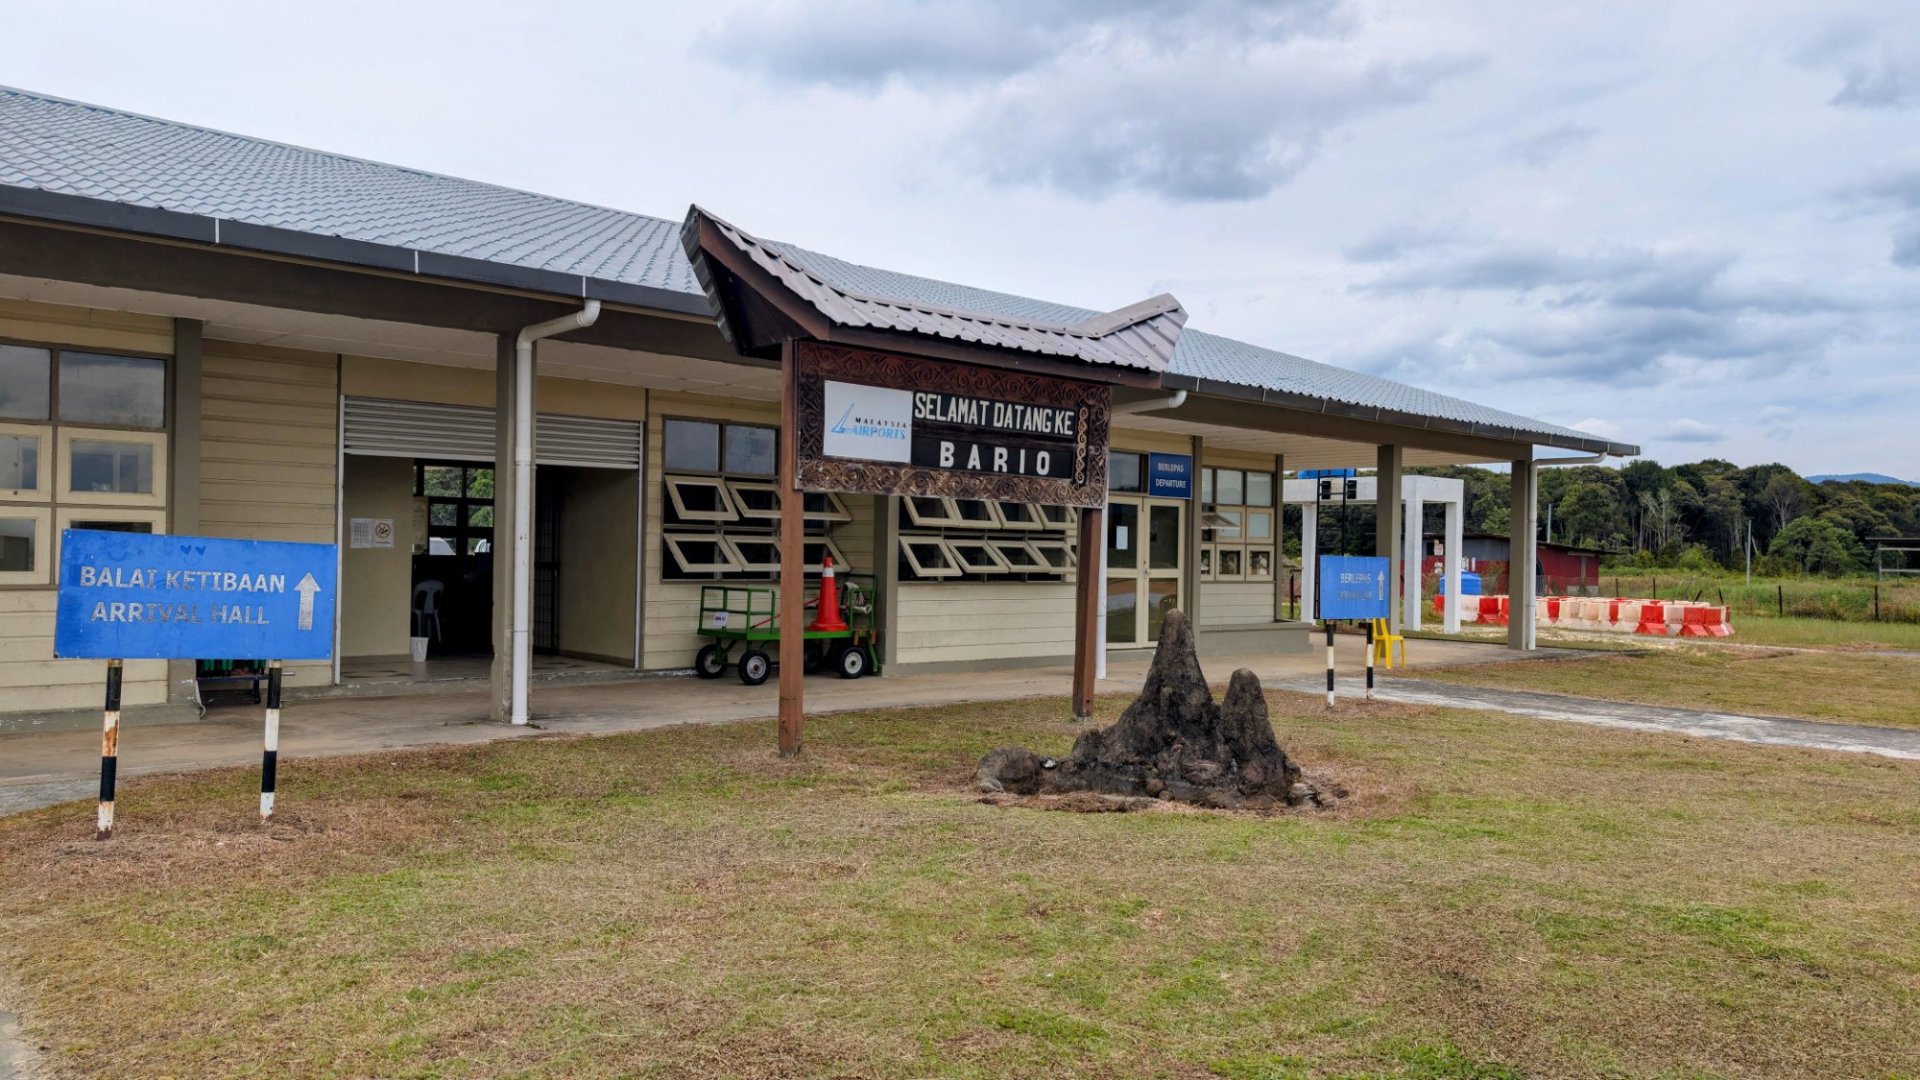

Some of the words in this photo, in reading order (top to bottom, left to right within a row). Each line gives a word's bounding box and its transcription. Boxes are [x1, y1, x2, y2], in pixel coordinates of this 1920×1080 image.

[855, 416, 907, 428] MALAYSIA
[915, 392, 990, 427] SELAMAT
[993, 402, 1052, 433] DATANG
[1054, 410, 1075, 436] KE
[852, 425, 906, 440] AIRPORTS
[939, 440, 1050, 476] BARIO
[1157, 462, 1185, 473] BERLEPAS
[1155, 478, 1187, 489] DEPARTURE
[80, 566, 157, 589] BALAI
[166, 570, 285, 593] KETIBAAN
[91, 601, 204, 624] ARRIVAL
[211, 605, 270, 625] HALL
